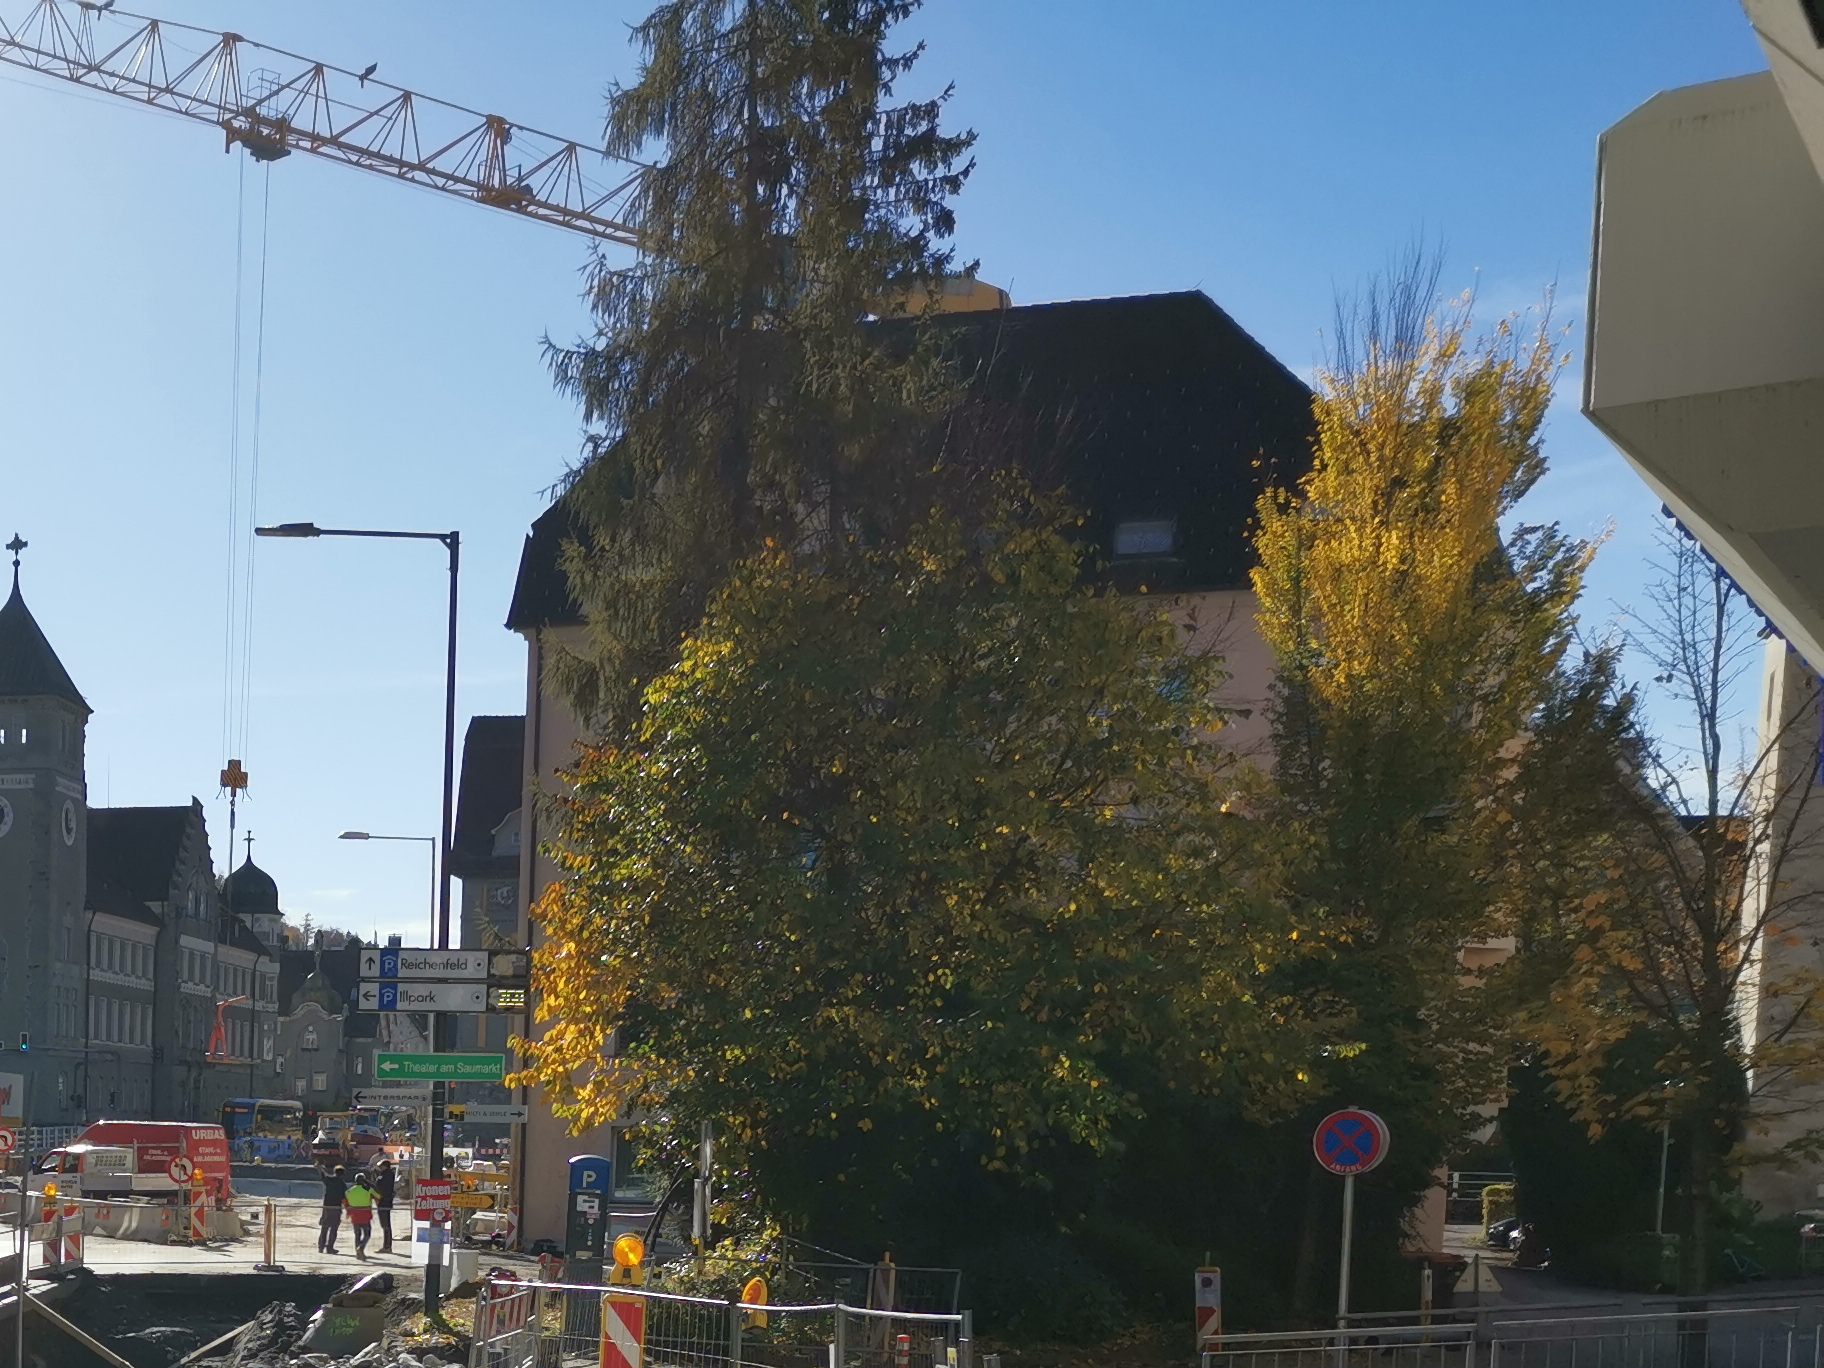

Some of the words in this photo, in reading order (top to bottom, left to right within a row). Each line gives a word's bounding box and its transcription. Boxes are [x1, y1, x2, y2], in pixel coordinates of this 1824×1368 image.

[401, 958, 468, 971] Reichenfeld
[399, 990, 436, 1006] Illpark
[403, 1061, 439, 1073] Theater
[440, 1064, 455, 1073] am
[457, 1062, 501, 1074] Saumarkt
[192, 1129, 225, 1140] URBAS
[582, 1171, 596, 1188] P
[416, 1184, 451, 1196] Kronen
[416, 1198, 451, 1209] Zeitung
